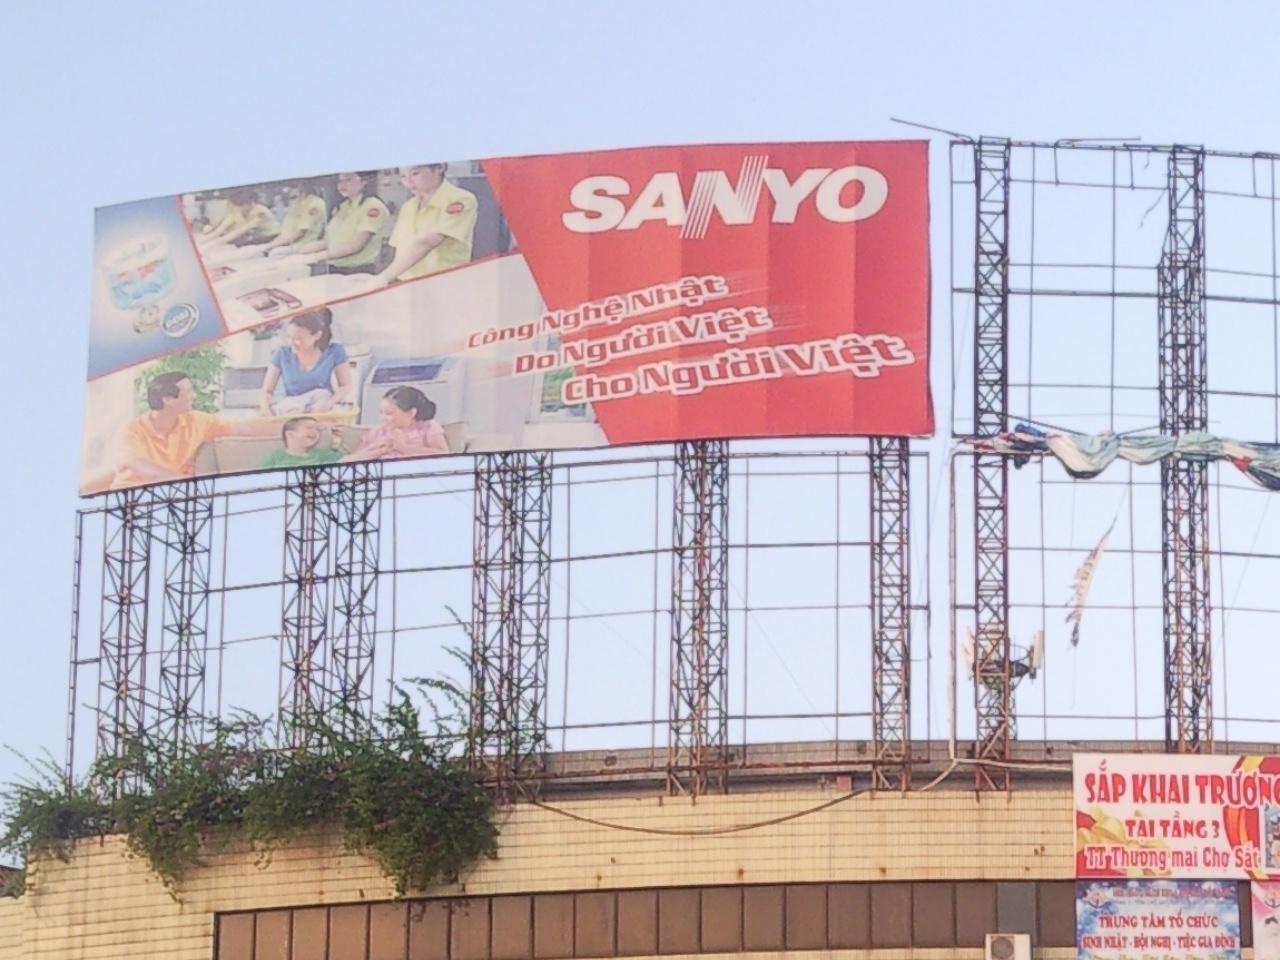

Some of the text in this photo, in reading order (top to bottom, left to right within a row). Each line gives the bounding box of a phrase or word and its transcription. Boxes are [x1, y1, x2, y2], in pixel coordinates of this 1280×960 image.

[562, 155, 889, 239] SANYO
[468, 277, 726, 349] Công Nghệ Nhật
[515, 309, 771, 374] Do Người Việt
[563, 337, 910, 402] Cho Người Việt
[1085, 760, 1126, 804] SẮP
[1131, 773, 1190, 804] KHAI
[1125, 811, 1220, 842] TẠI TẦNG 3
[1171, 847, 1198, 872] mại
[1203, 846, 1230, 872] Chợ
